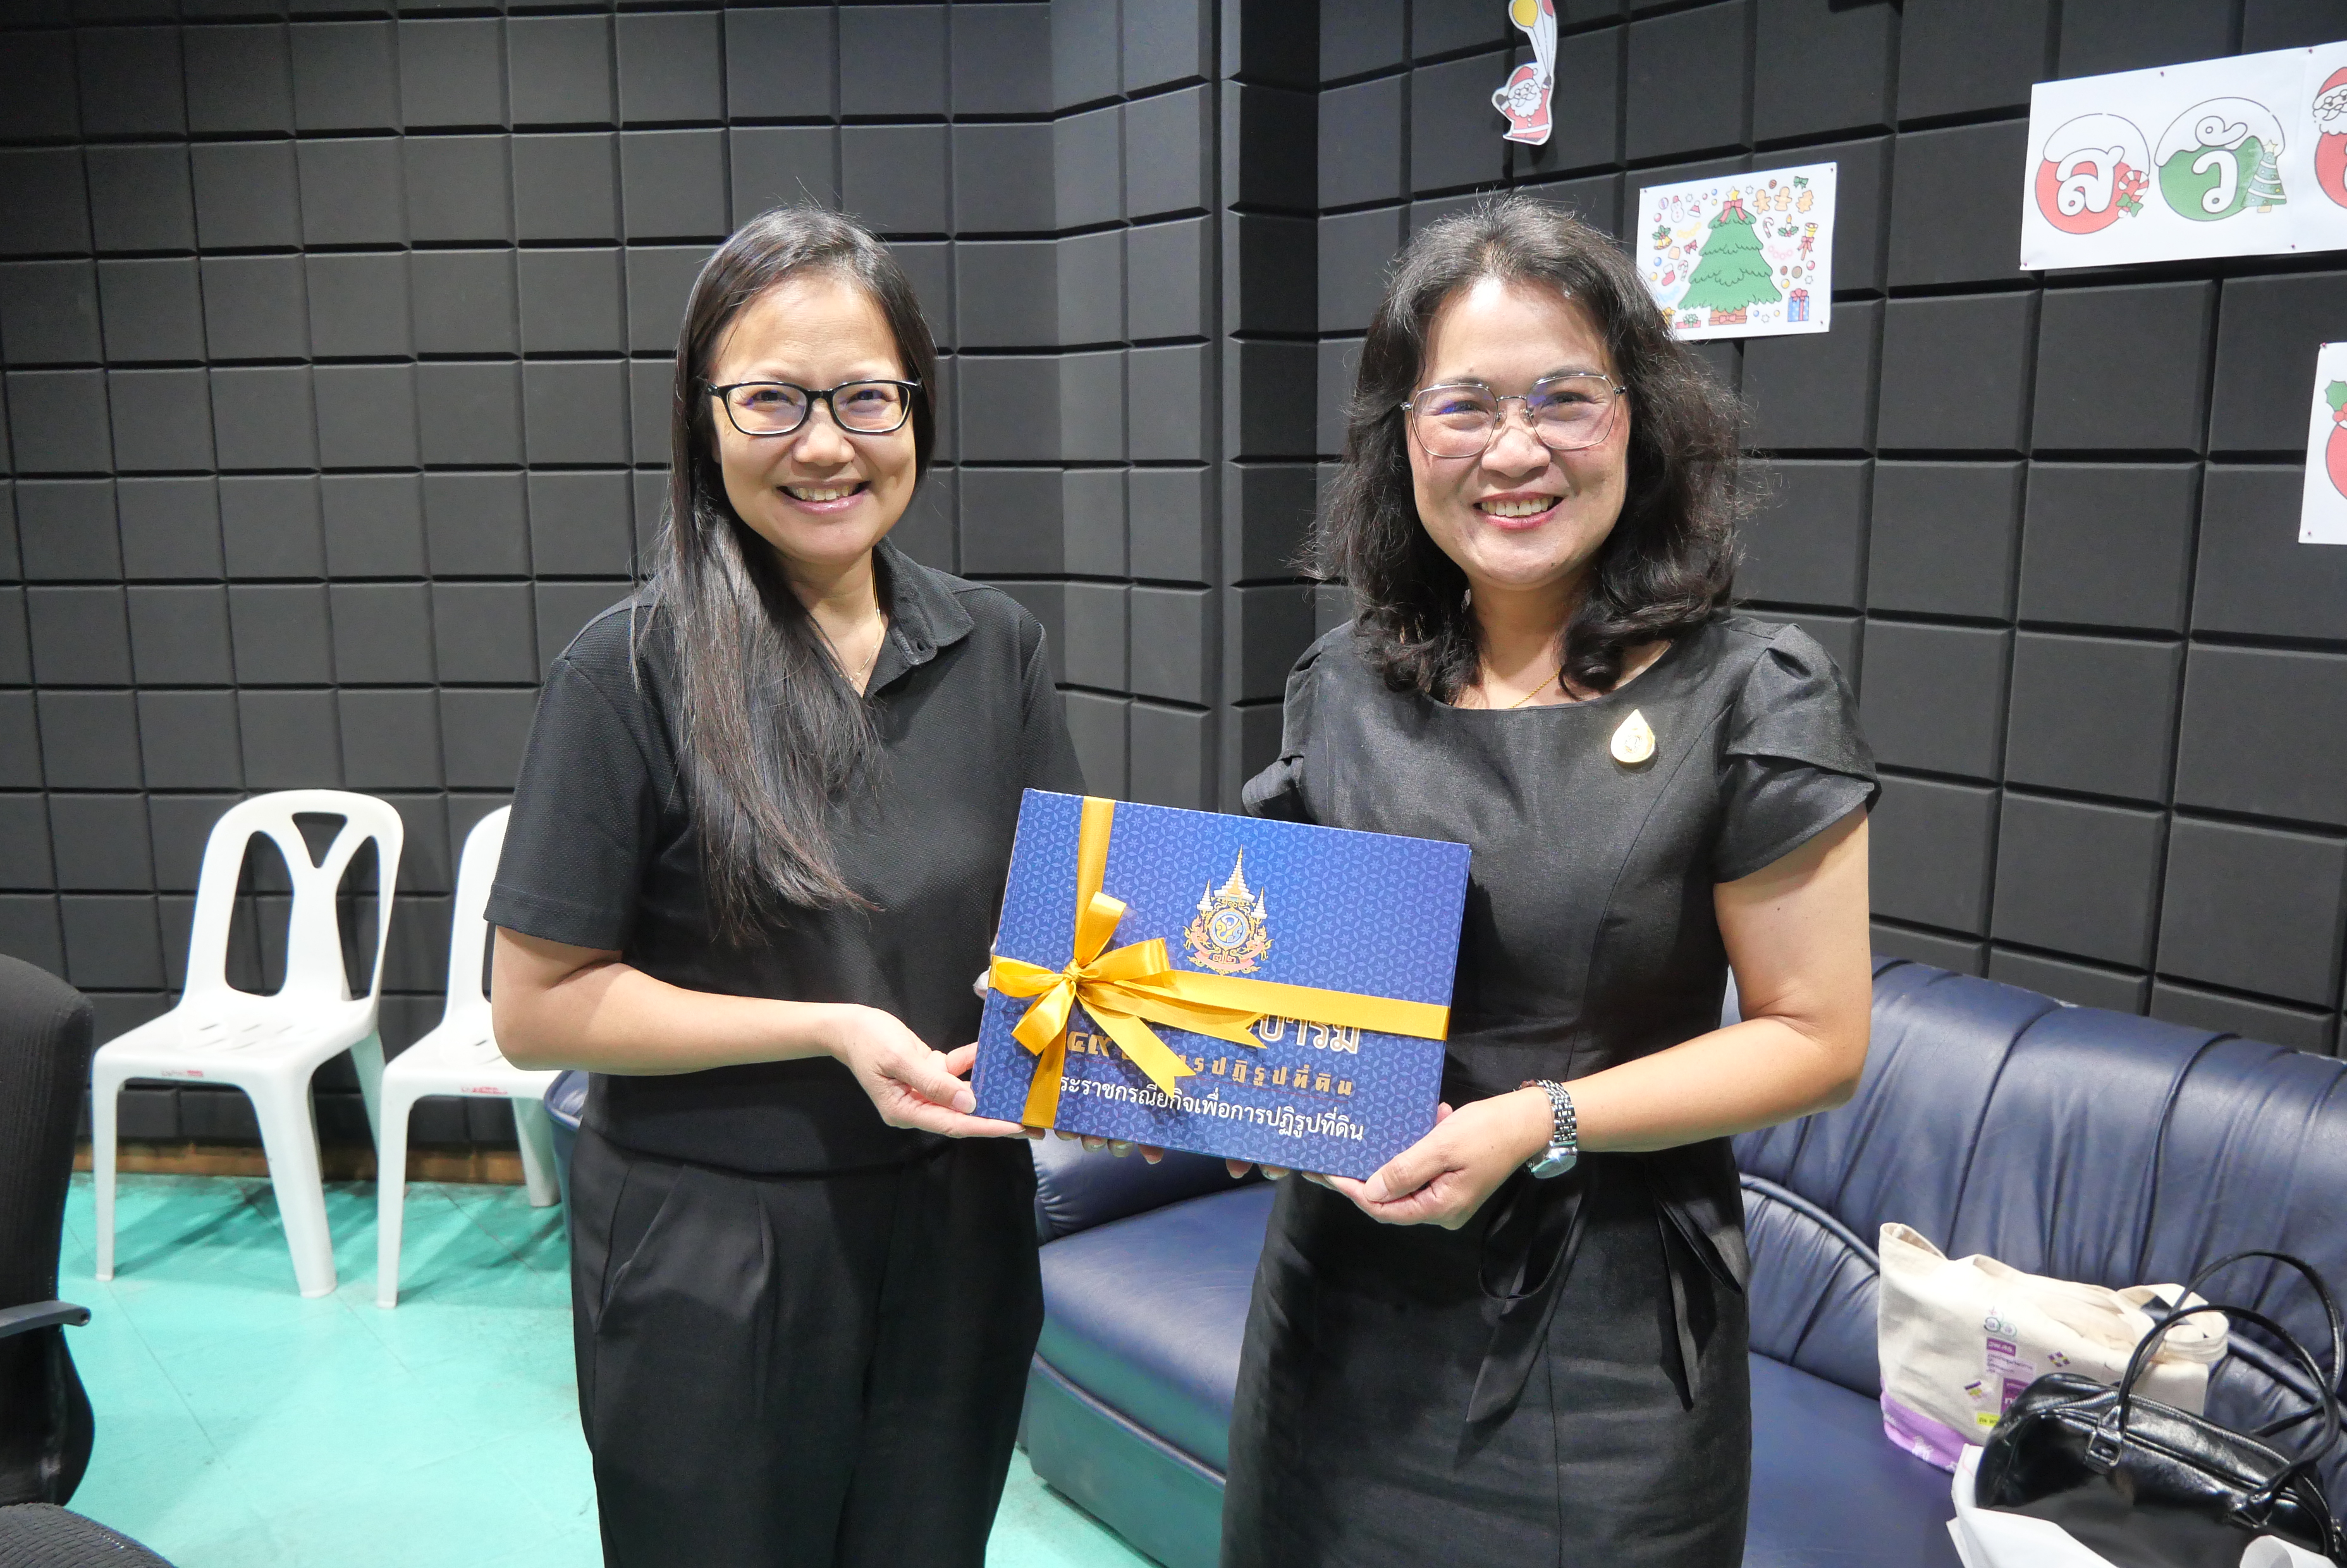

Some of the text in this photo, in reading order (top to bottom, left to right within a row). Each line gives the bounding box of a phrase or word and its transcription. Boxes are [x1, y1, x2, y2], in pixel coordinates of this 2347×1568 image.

[2056, 116, 2347, 216] สวั
[1060, 1076, 1364, 1141] ระราชกรณียกิจเพื่อการปฏิรูปที่ดิน
